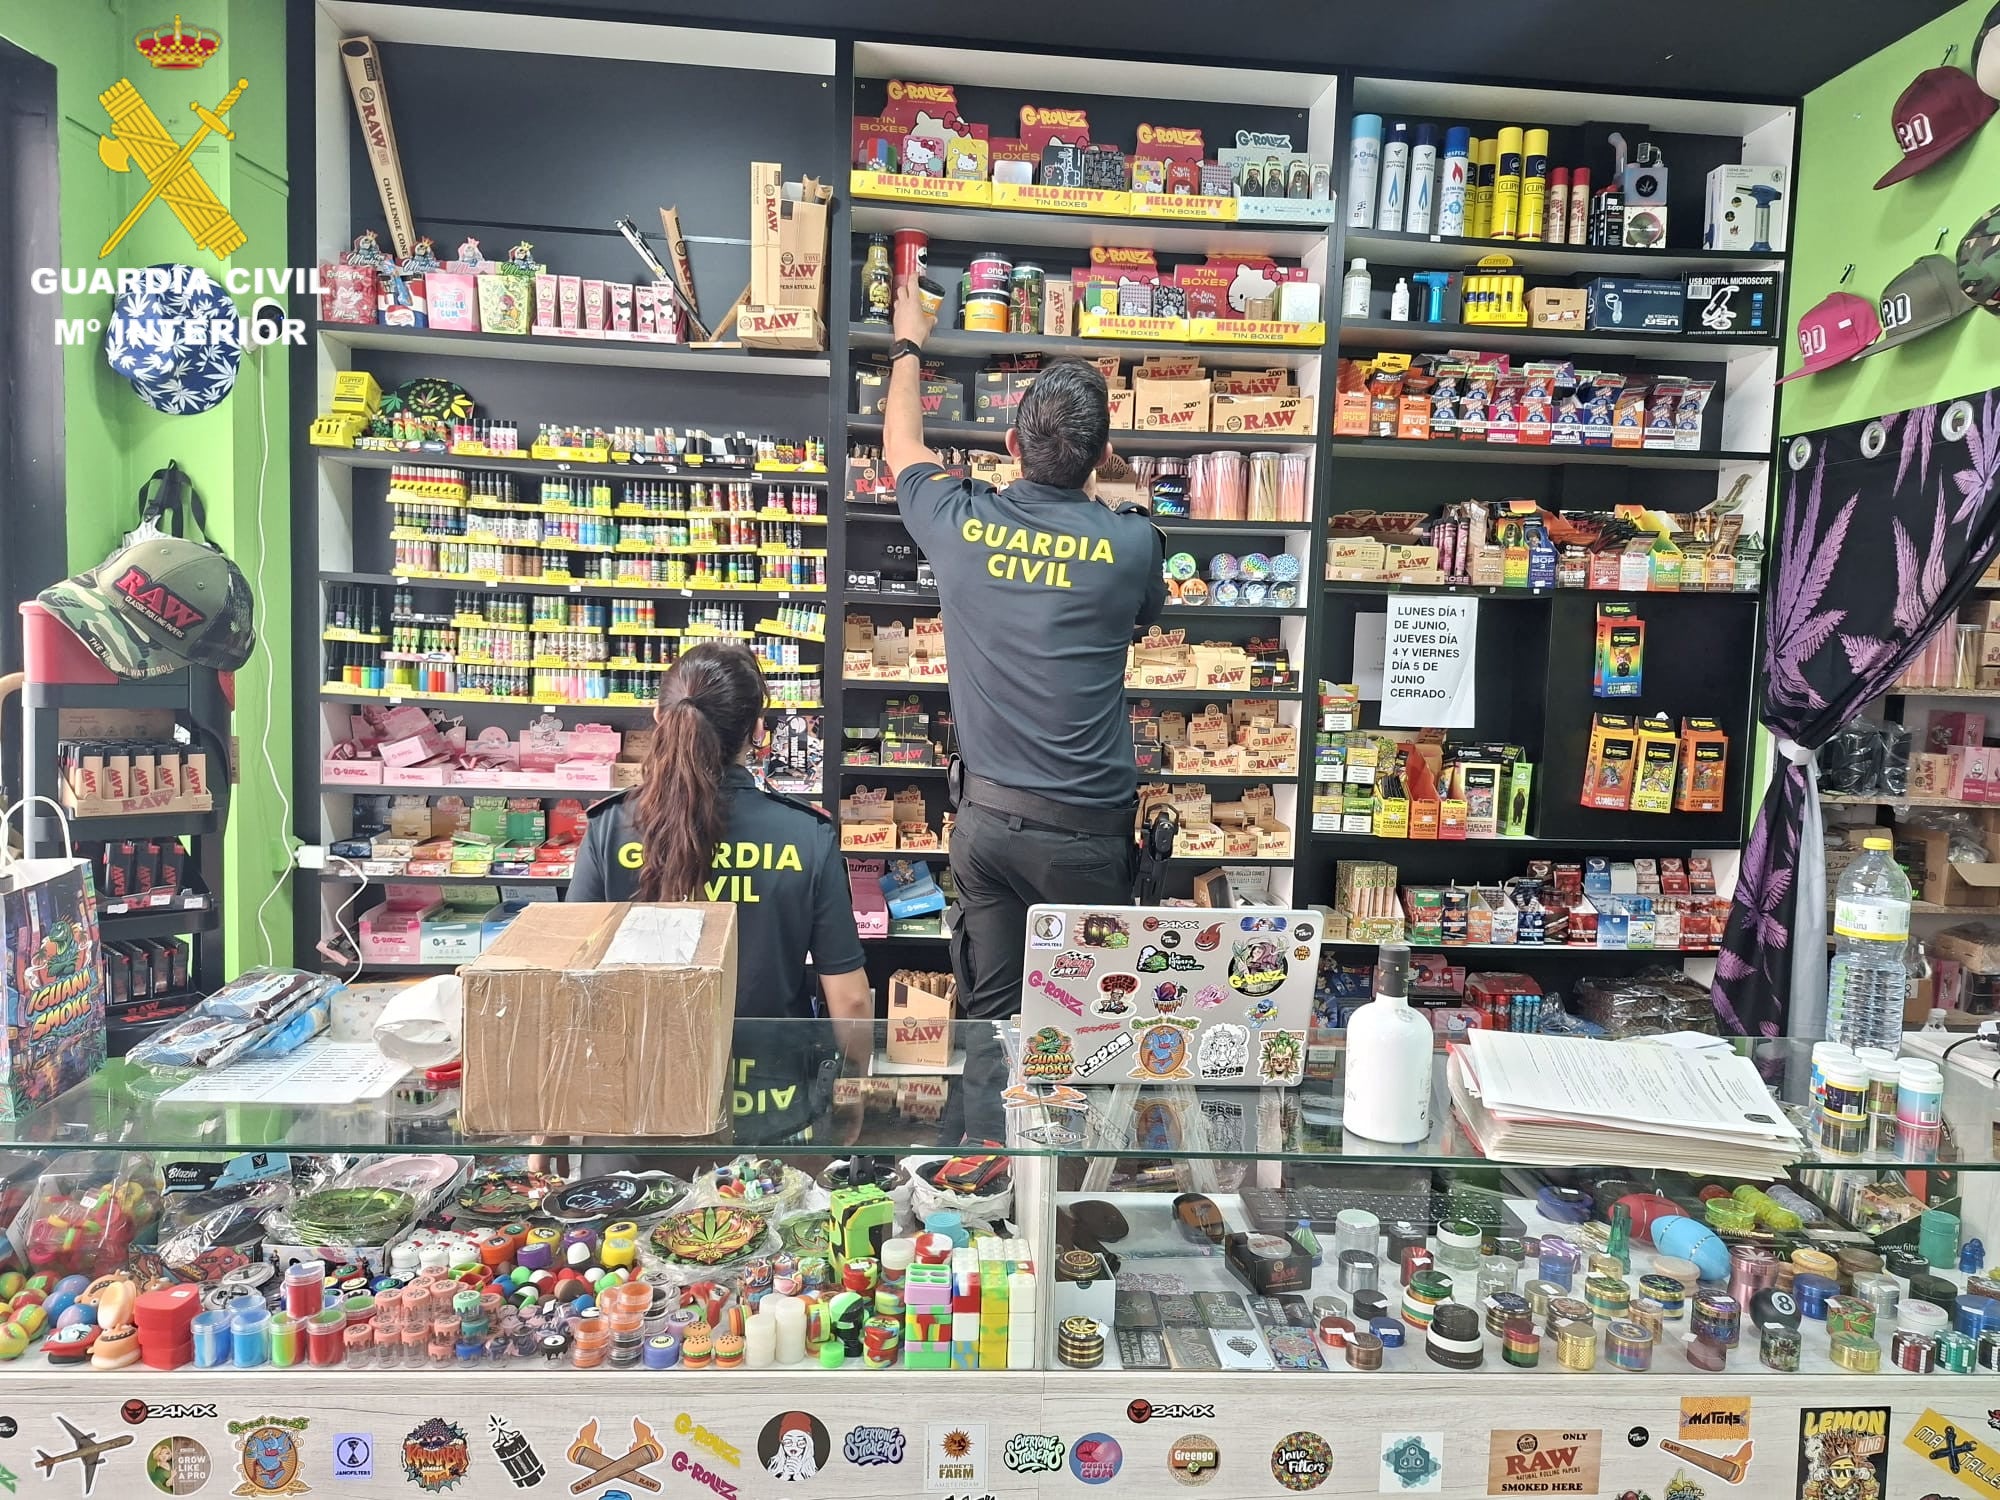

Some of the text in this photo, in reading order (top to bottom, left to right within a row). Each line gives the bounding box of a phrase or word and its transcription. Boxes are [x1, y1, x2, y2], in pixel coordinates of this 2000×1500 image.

[874, 117, 896, 125] TIN
[859, 123, 908, 134] BOXES
[1006, 143, 1029, 152] TIN
[992, 150, 1041, 161] BOXES
[878, 174, 965, 192] HELLO KITTY
[895, 187, 949, 198] TIN BOXES
[1018, 186, 1105, 202] HELLO KITTY
[1034, 198, 1088, 209] TIN BOXES
[1146, 195, 1223, 209] HELLO KITTY
[1177, 208, 1207, 216] BOXES
[1195, 268, 1218, 277] TIN
[1181, 277, 1228, 287] BOXES
[1689, 276, 1773, 286] USB DIGITAL MICROSCOPE
[752, 312, 800, 332] RAW
[1099, 317, 1175, 330] HELLO KITTY
[1216, 321, 1301, 334] HELLO KITTY
[1251, 332, 1284, 340] BOXES
[1158, 411, 1195, 426] RAW
[1244, 410, 1296, 432] RAW
[1155, 482, 1183, 494] Glass
[1157, 501, 1185, 515] Glass
[962, 518, 1115, 564] GUARDIA
[887, 544, 911, 554] OCB
[1336, 549, 1356, 557] RAW
[1397, 557, 1430, 569] RAW
[987, 554, 1073, 588] CIVIL
[848, 574, 876, 585] OCB
[115, 568, 204, 629] RAW
[125, 595, 147, 613] CLASSIC
[1398, 606, 1465, 617] LUNES DÍA 1
[1394, 620, 1450, 632] DE JUNIO,
[1393, 633, 1458, 644] JUEVES DÍA
[88, 637, 175, 677] THE TO ROLL
[1392, 648, 1460, 658] 4 Y VIERNES
[845, 661, 871, 673] RAW
[1392, 659, 1438, 671] DÍA 5 DE
[880, 668, 902, 678] RAW
[1154, 673, 1187, 685] RAW
[1207, 670, 1244, 685] RAW
[1390, 675, 1425, 685] JUNIO
[1390, 689, 1446, 699] CERRADO
[1261, 735, 1289, 747] RAW
[893, 749, 924, 763] RAW
[1177, 759, 1200, 770] RAW
[1209, 757, 1234, 768] RAW
[113, 768, 125, 798] RAW
[122, 790, 174, 813] RAW
[1175, 792, 1204, 803] RAW
[853, 831, 888, 845] RAW
[908, 838, 932, 848] RAW
[1190, 840, 1216, 851] RAW
[1229, 842, 1251, 852] RAW
[1264, 840, 1285, 850] RAW
[114, 865, 126, 896] RAW
[140, 865, 151, 894] RAW
[1158, 920, 1200, 929] 24MX
[1102, 974, 1137, 984] CRAZY
[27, 969, 91, 1015] IGUANA
[33, 992, 92, 1039] SMOKE
[895, 1026, 945, 1043] RAW
[1023, 1054, 1074, 1065] IGUANA
[1025, 1064, 1072, 1076] SMOKE
[1777, 1292, 1793, 1312] 8
[147, 1403, 218, 1418] 24MX
[1150, 1404, 1215, 1419] 24MX
[1804, 1410, 1886, 1436] LEMON
[852, 1425, 893, 1443] EVERYONE
[1562, 1432, 1588, 1441] ONLY
[1013, 1433, 1056, 1451] EVERYONE
[1662, 1442, 1682, 1453] RAW
[1857, 1437, 1882, 1452] KING
[843, 1437, 904, 1460] STICKERS
[178, 1456, 206, 1464] GROW
[1004, 1444, 1064, 1468] STICKERS
[1174, 1450, 1214, 1463] Greengo
[1278, 1448, 1308, 1465] Jano
[1505, 1445, 1581, 1476] RAW
[178, 1464, 200, 1473] LIKE
[1081, 1467, 1115, 1479] GUM
[1288, 1459, 1327, 1475] Filters
[178, 1472, 206, 1480] A PRO
[938, 1468, 974, 1480] FARM
[1516, 1467, 1581, 1481] NATURAL ROLLING PAPERS
[573, 1482, 593, 1493] RAW
[638, 1476, 657, 1490] RAW
[933, 1480, 980, 1488] AMSTERDAM
[1502, 1482, 1584, 1492] SMOKED HERE
